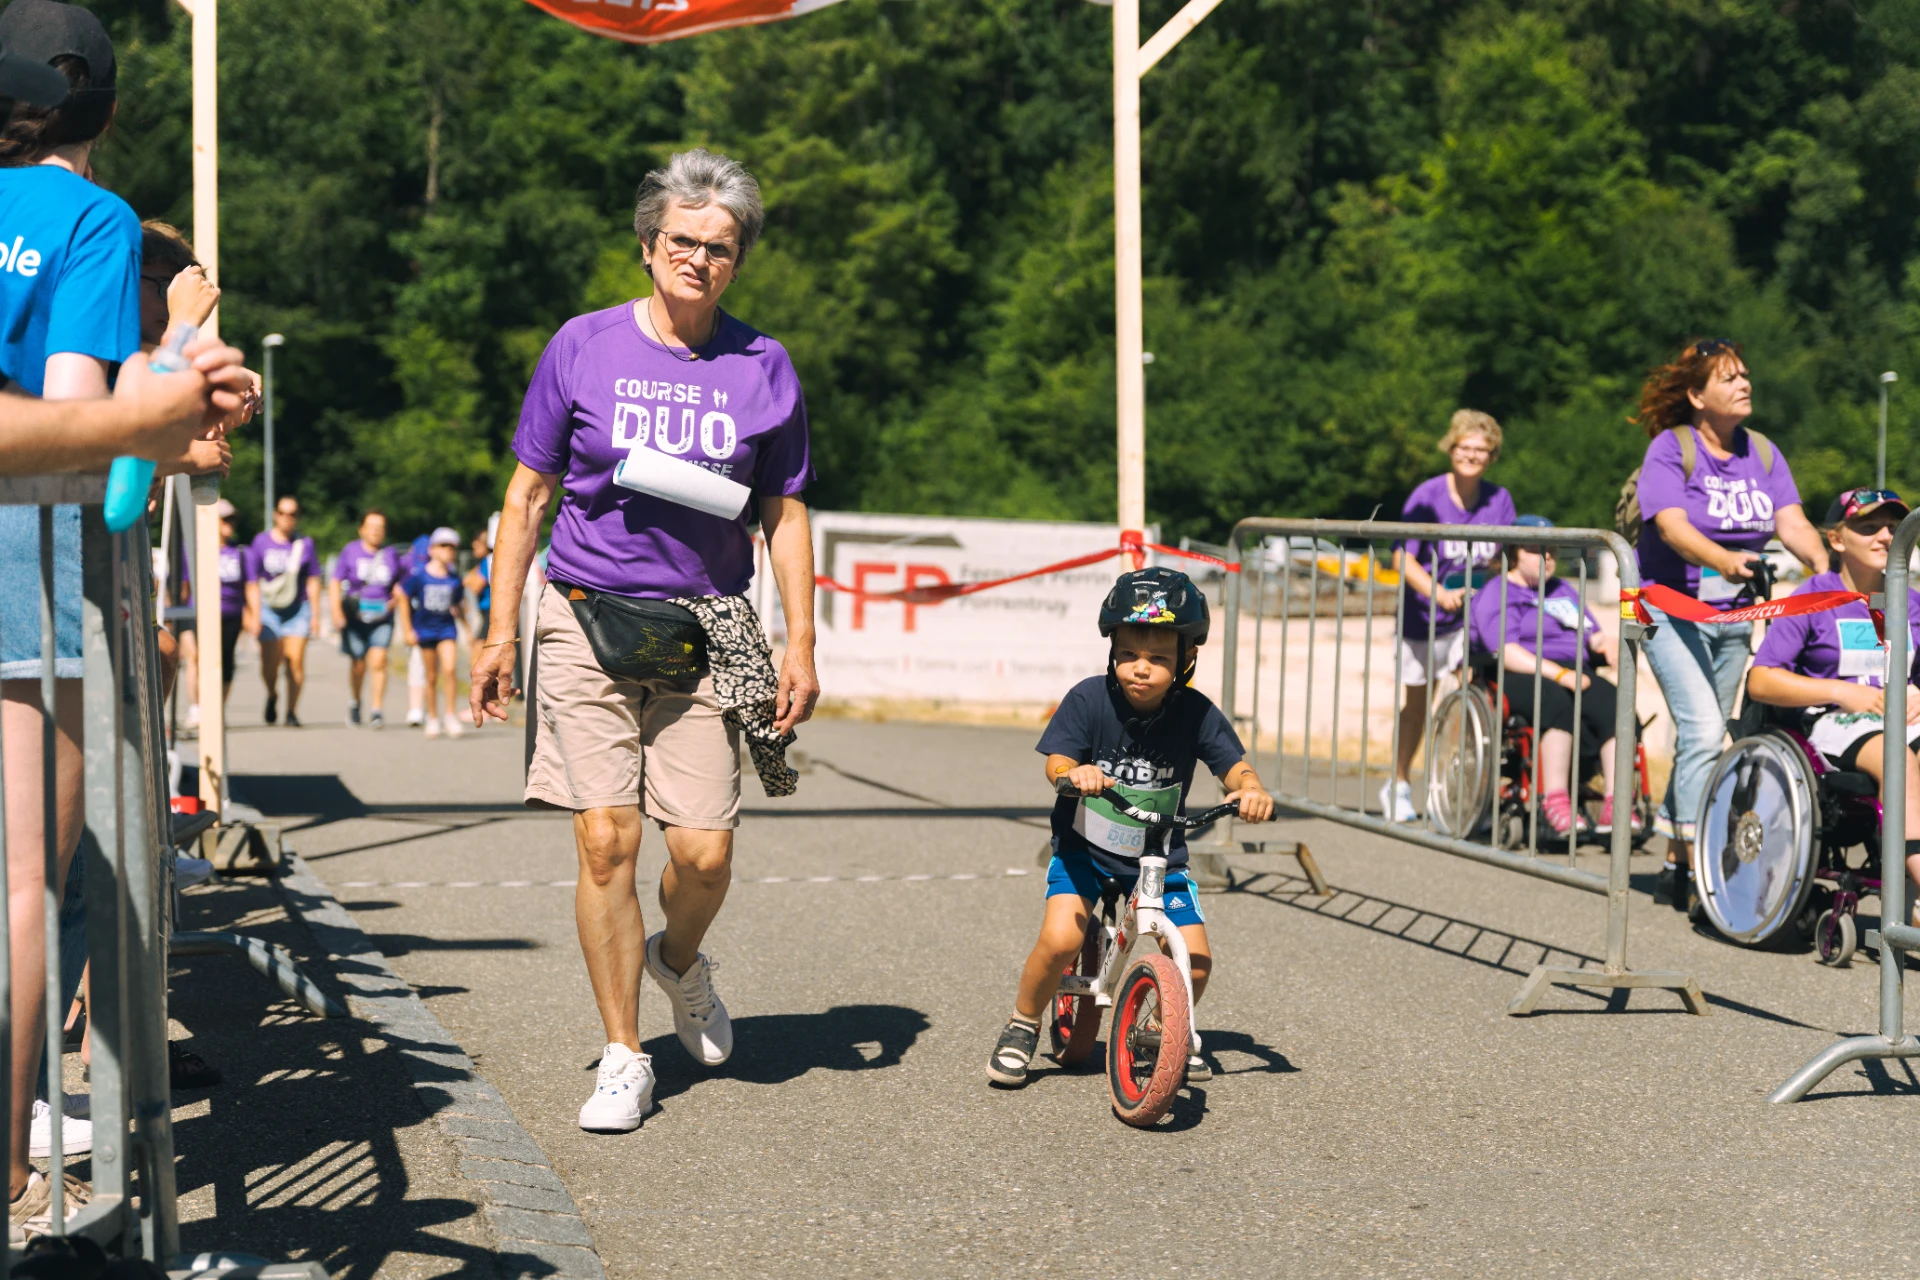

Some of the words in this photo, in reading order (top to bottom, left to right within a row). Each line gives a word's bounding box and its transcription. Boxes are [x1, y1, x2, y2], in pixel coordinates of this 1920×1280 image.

[614, 378, 702, 404] COURSE
[611, 402, 737, 460] DUO
[1706, 489, 1774, 522] DUO
[1107, 828, 1142, 847] DUO
